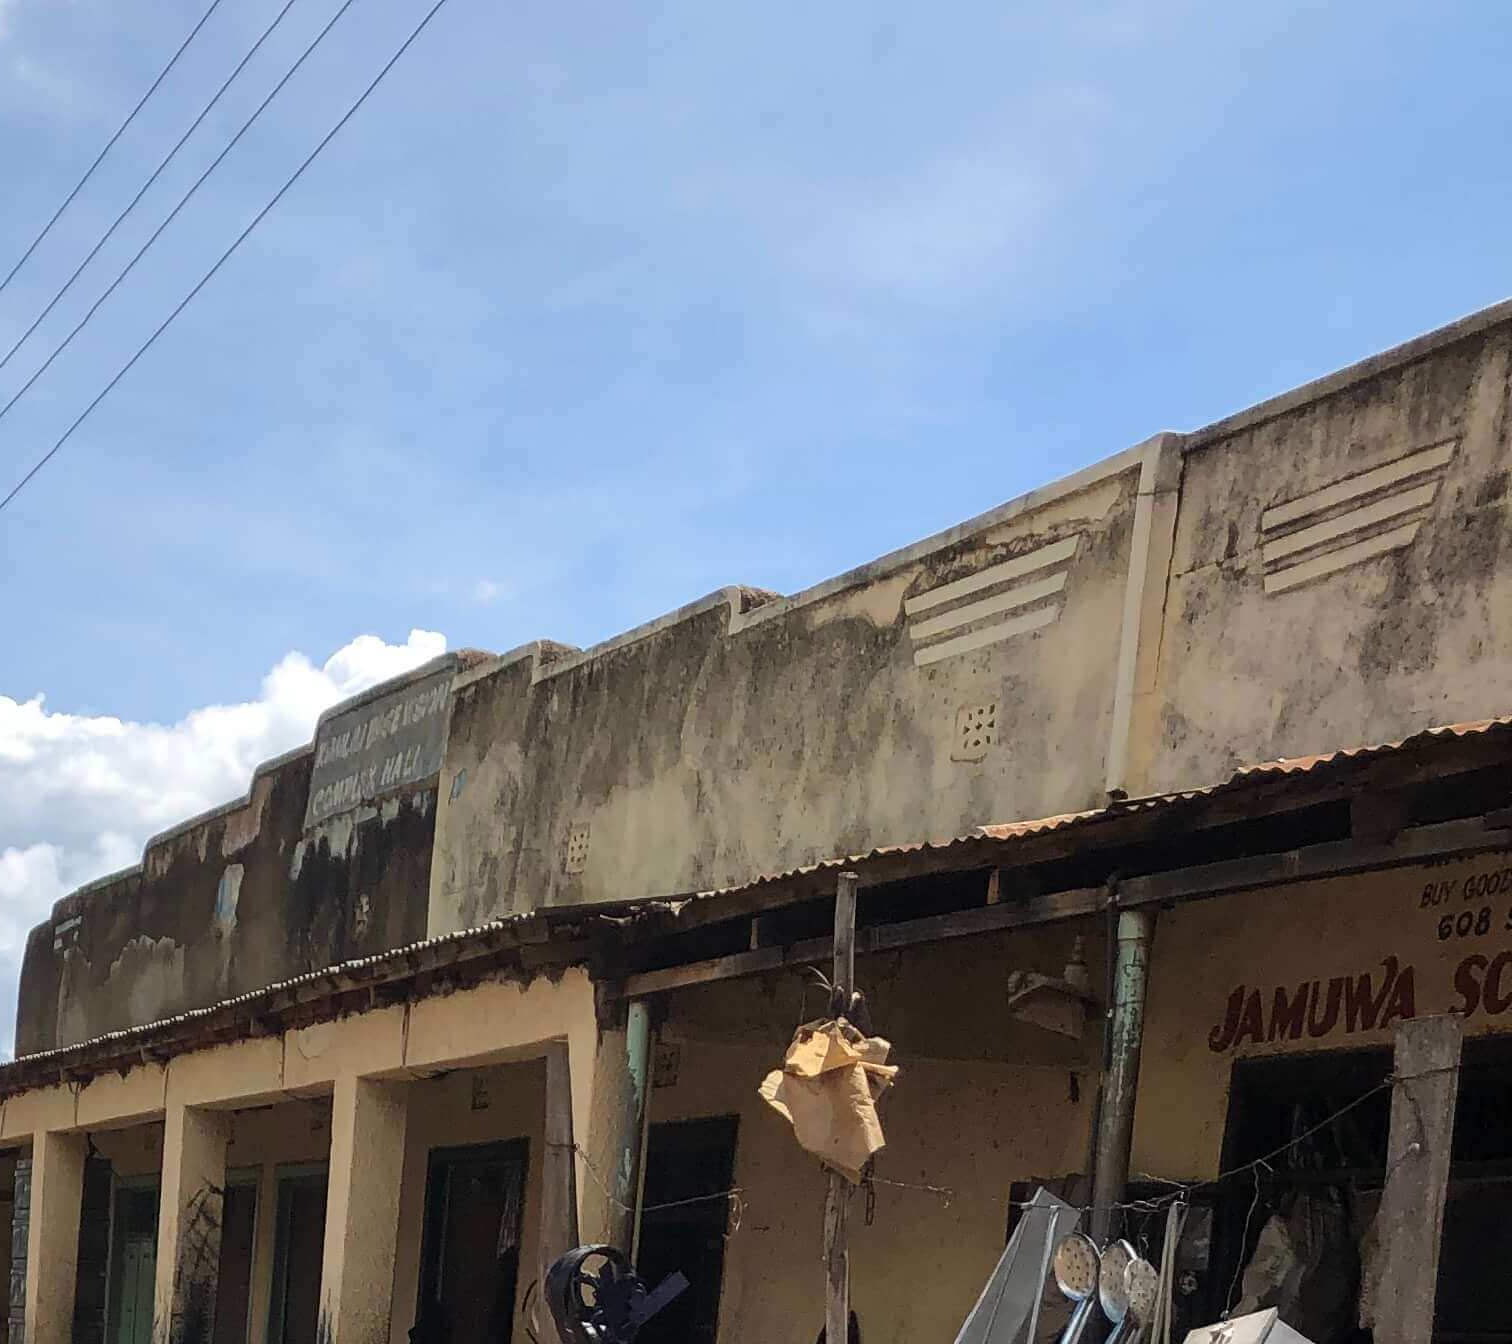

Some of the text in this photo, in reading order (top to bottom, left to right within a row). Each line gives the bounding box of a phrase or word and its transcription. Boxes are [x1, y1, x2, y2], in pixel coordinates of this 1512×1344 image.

[1418, 880, 1457, 908] BUY
[1438, 906, 1492, 941] 608
[1208, 956, 1415, 1053] JAMUWA
